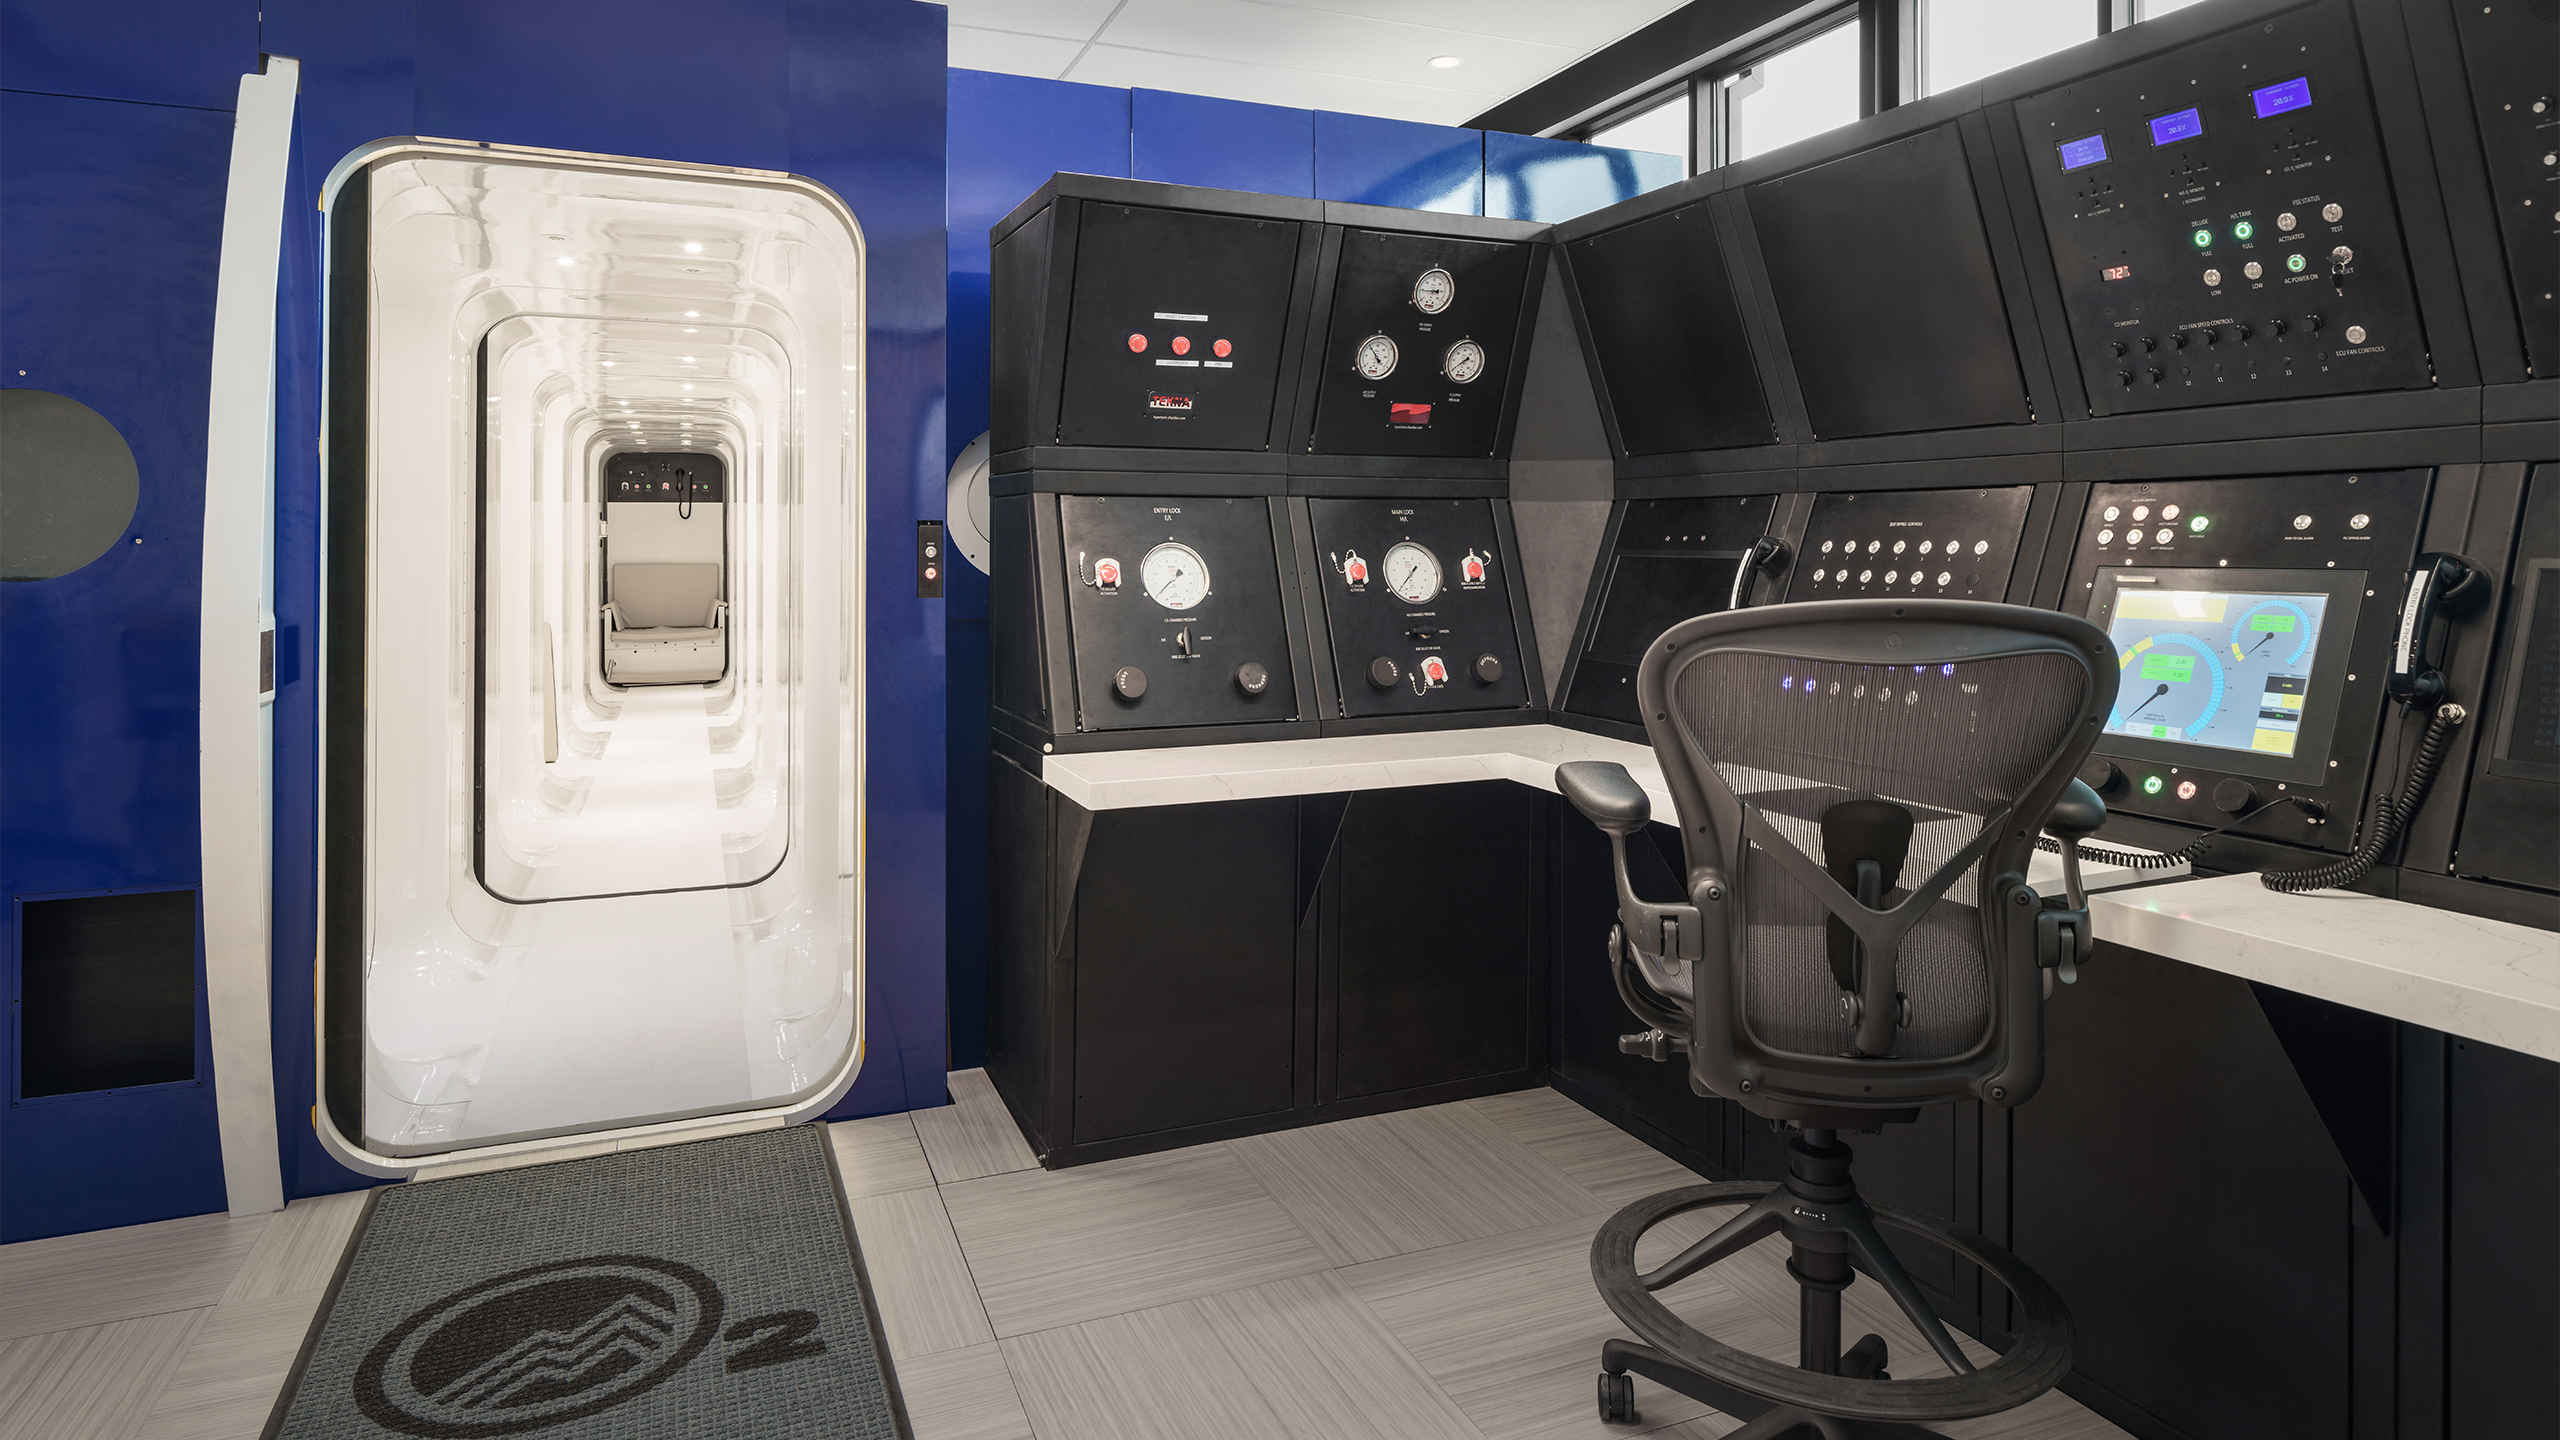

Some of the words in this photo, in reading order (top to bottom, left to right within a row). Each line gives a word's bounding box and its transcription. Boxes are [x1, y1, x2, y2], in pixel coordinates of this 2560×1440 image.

[2292, 198, 2302, 206] FSS
[2302, 194, 2321, 204] STATUS
[2239, 210, 2252, 218] TANK
[2331, 225, 2343, 233] TEST
[2279, 232, 2305, 243] ACTIVATED
[2243, 242, 2254, 250] FULL
[2291, 275, 2309, 283] POWER
[2310, 273, 2318, 281] ON
[2252, 282, 2263, 290] LOW
[2211, 289, 2222, 297] LOW
[2211, 318, 2234, 326] CONTROLS
[2358, 345, 2385, 355] CONTROLS
[1153, 395, 1190, 408] TEKNA
[2408, 588, 2420, 610] ENTRY
[2405, 610, 2414, 627] LOCK
[2400, 629, 2410, 652] PHONE
